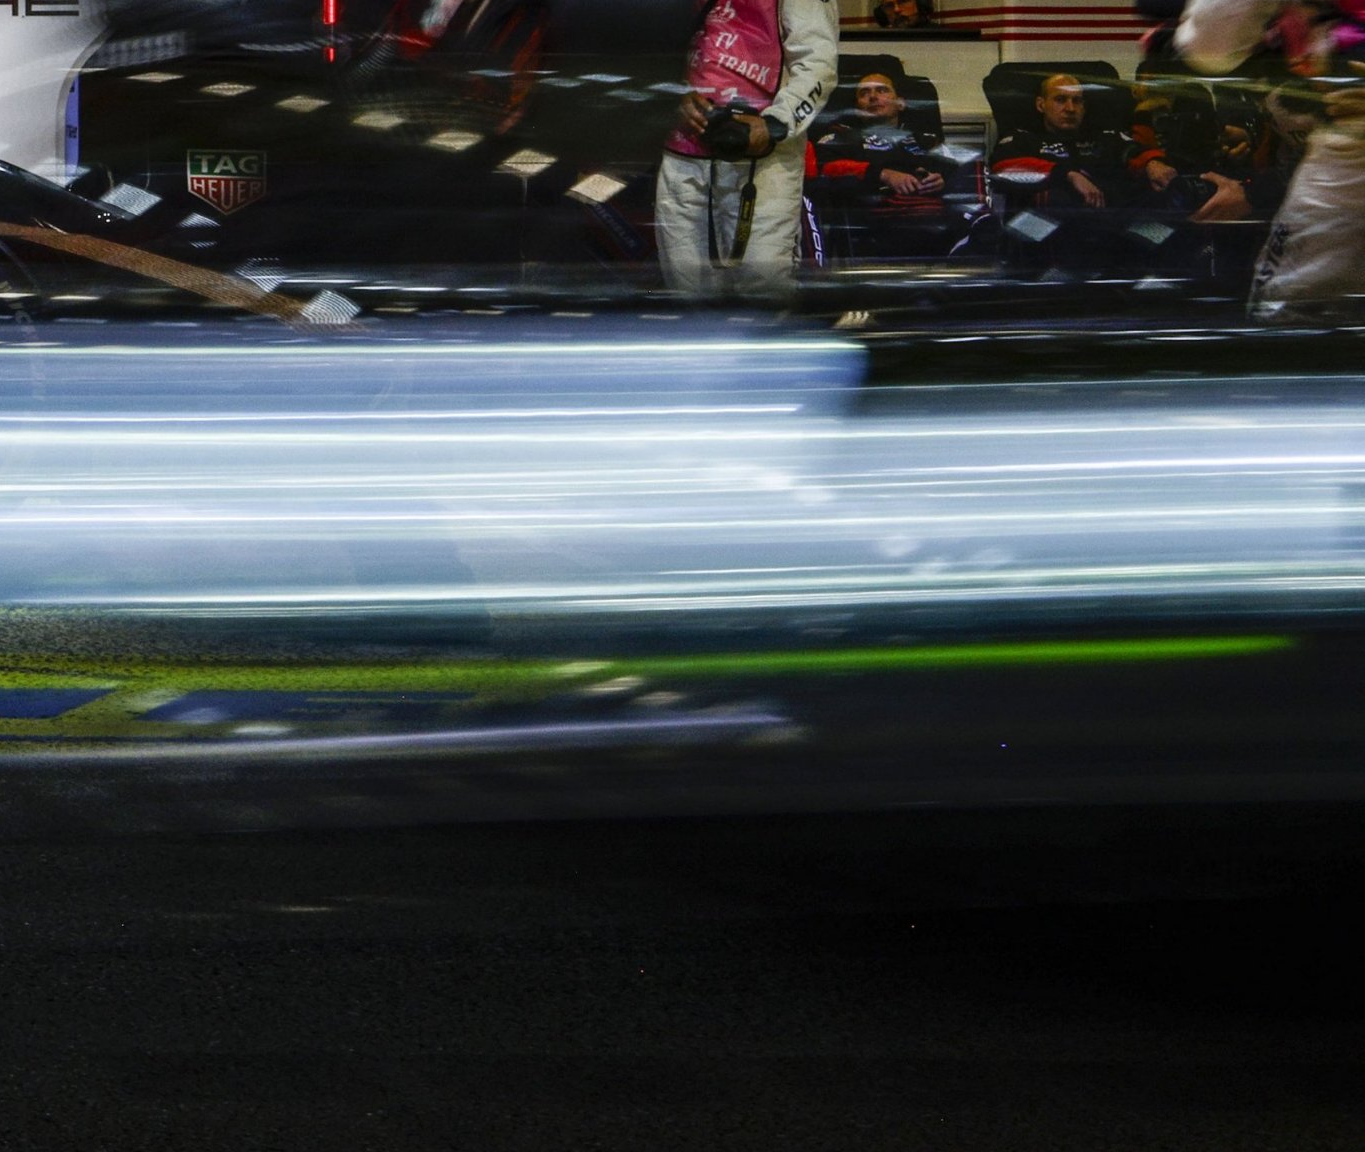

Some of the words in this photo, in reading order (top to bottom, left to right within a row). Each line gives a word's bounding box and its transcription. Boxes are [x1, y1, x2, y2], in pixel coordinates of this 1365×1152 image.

[718, 52, 771, 86] TRACK
[809, 81, 823, 104] TV
[194, 154, 259, 174] TAG
[193, 178, 262, 209] HEUER
